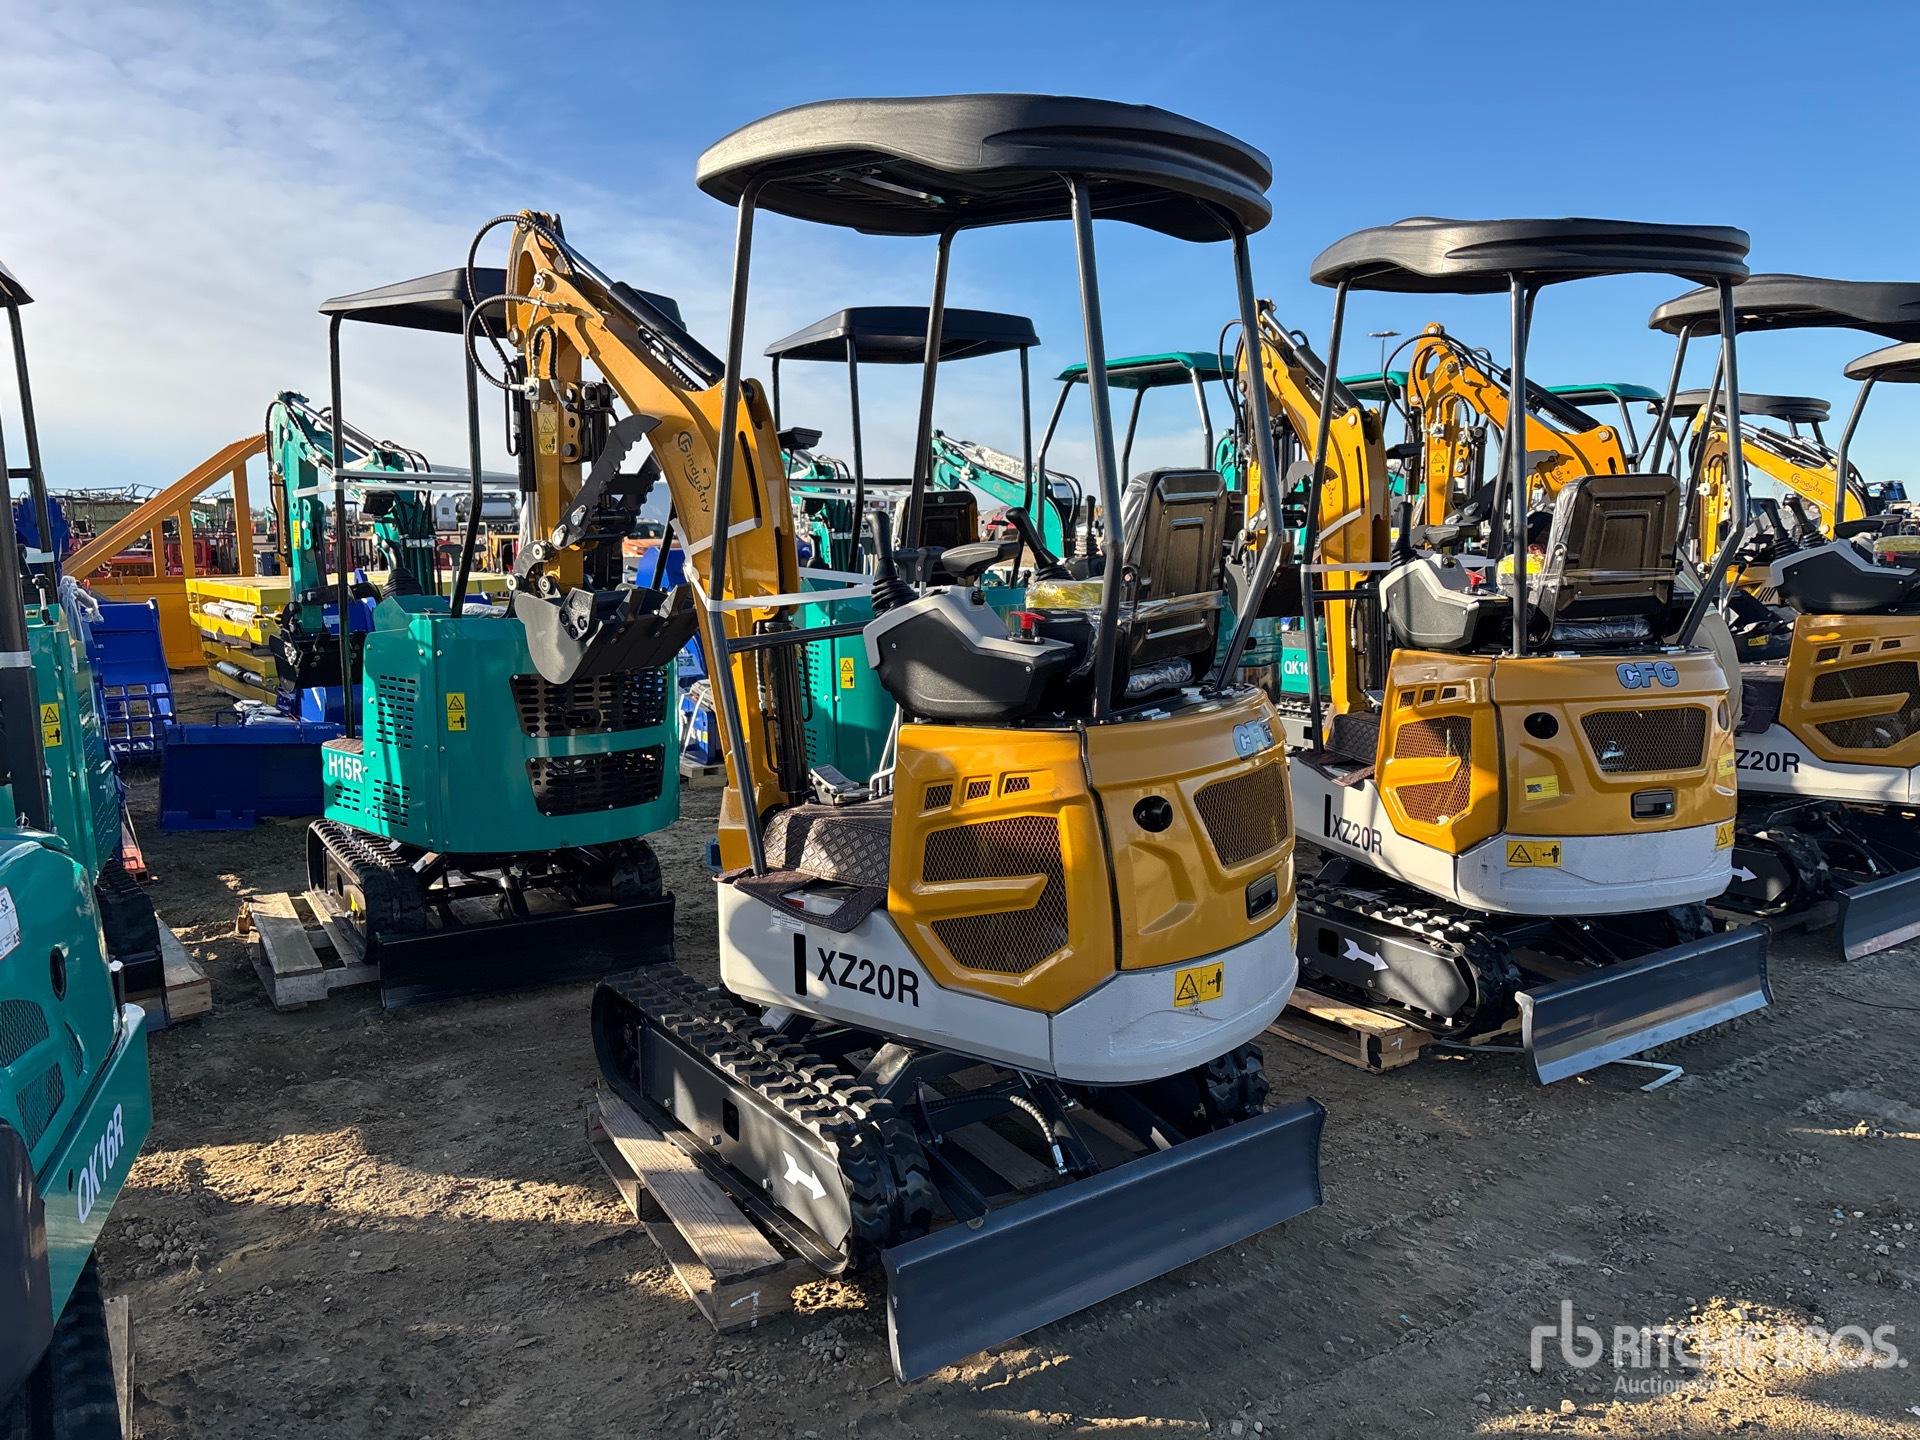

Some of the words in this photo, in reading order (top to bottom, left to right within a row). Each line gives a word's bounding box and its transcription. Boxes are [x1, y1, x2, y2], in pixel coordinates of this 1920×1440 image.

[1616, 661, 1679, 689] CFG
[328, 752, 363, 784] H15R
[1332, 814, 1382, 856] XZ20R
[817, 947, 919, 1007] XZ20R
